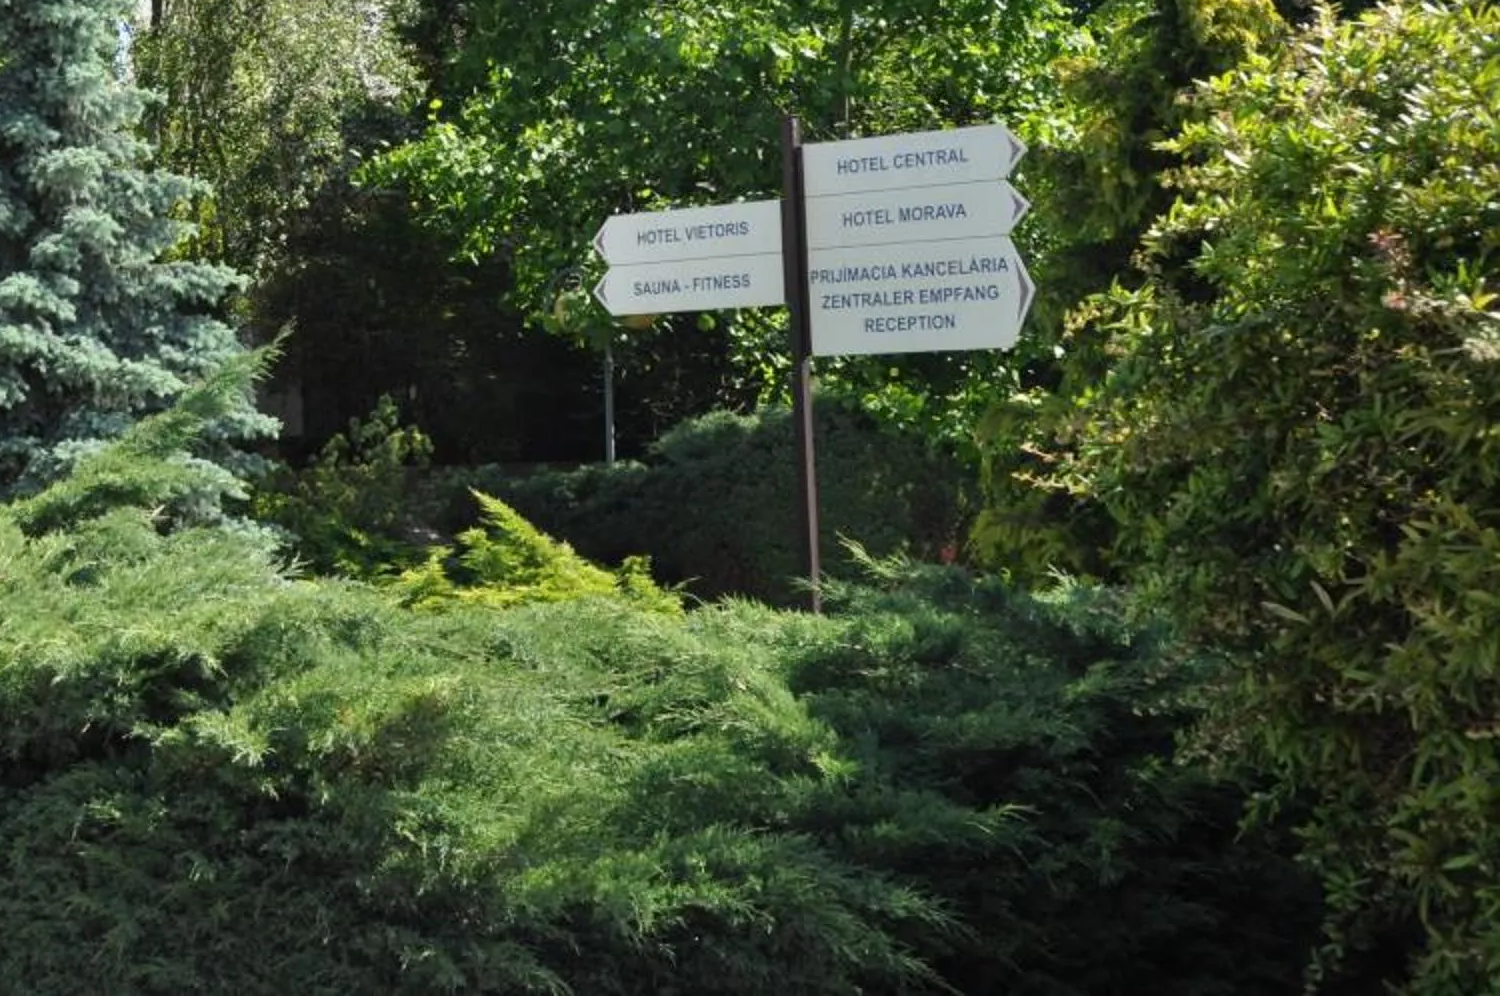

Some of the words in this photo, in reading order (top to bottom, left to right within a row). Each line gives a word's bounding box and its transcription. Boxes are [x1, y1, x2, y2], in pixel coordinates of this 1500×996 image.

[837, 155, 888, 175] HOTEL
[893, 148, 968, 169] CENTRAL
[843, 209, 894, 228] HOTEL
[898, 203, 967, 223] MORAVA
[637, 229, 682, 246] HOTEL
[685, 221, 749, 241] VIETORIS
[633, 279, 681, 297] SAUNA
[692, 273, 751, 292] FITNESS
[821, 290, 914, 310] ZENTRALER
[919, 284, 999, 305] EMPFANG
[865, 314, 956, 333] RECEPTION
